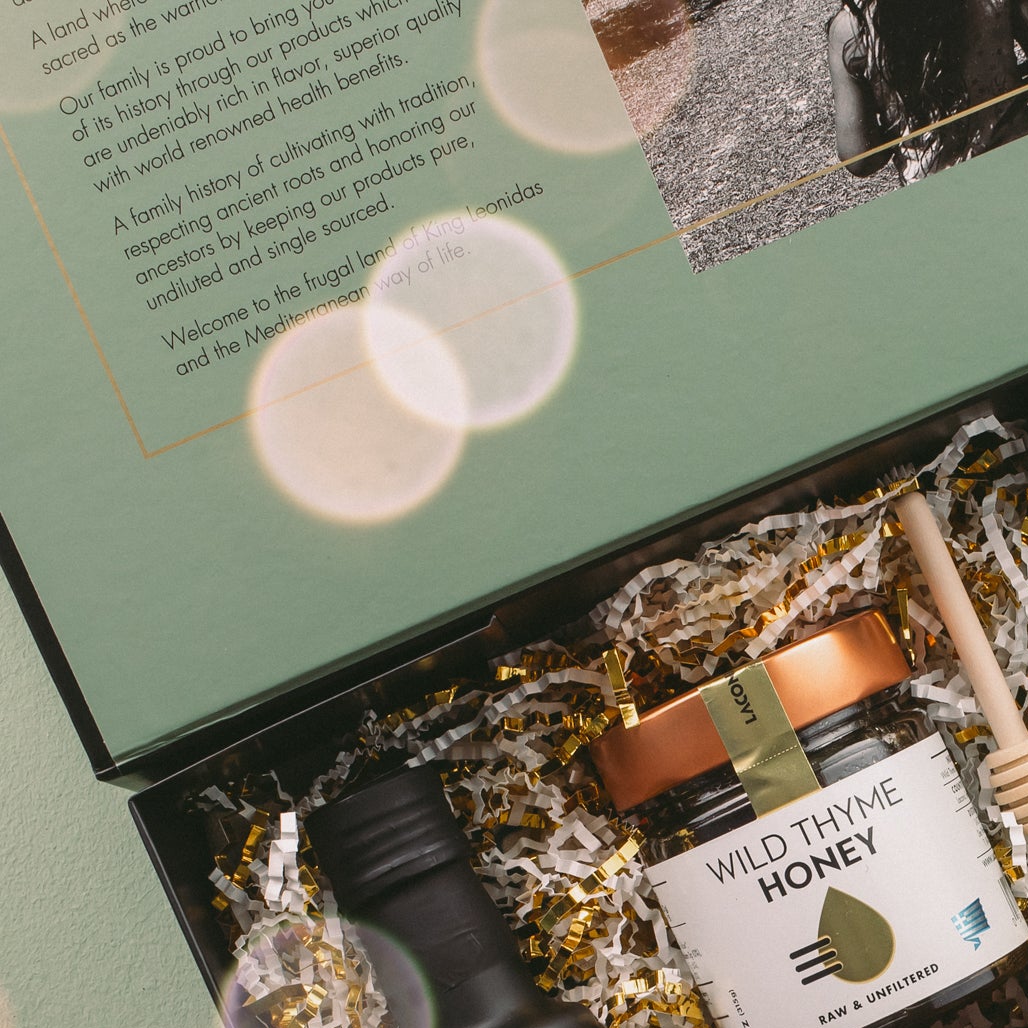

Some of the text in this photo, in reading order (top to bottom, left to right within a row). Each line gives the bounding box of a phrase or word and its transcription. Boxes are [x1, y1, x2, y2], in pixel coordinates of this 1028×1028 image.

[32, 30, 47, 50] A
[46, 8, 89, 41] land
[42, 34, 101, 75] sacred
[105, 31, 127, 48] as
[129, 17, 158, 38] the
[59, 93, 94, 115] Our
[97, 66, 150, 100] family
[154, 61, 170, 76] is
[174, 30, 226, 74] proud
[229, 29, 248, 45] to
[249, 8, 299, 36] bring
[72, 118, 89, 142] of
[92, 116, 113, 133] its
[114, 90, 171, 123] history
[175, 57, 242, 98] through
[246, 47, 273, 68] our
[278, 15, 352, 61] products
[83, 0, 461, 168] are undeniably rich in flavor, superior quality
[93, 53, 408, 193] with world renowned health benefits.
[114, 76, 475, 236] A family history of cultivating with tradition,
[124, 101, 476, 260] respecting ancient roots and honoring our
[135, 136, 474, 285] ancestors by keeping our products pure,
[146, 192, 395, 310] undiluted and single sourced.
[161, 182, 544, 350] Welcome to the frugal land of King Leonidas
[176, 241, 471, 376] and the Mediterranean way of life.
[706, 834, 787, 884] WILD
[790, 777, 903, 846] THYME
[758, 826, 877, 903] HONEY
[818, 963, 939, 1025] RAW & UNFILTERED
